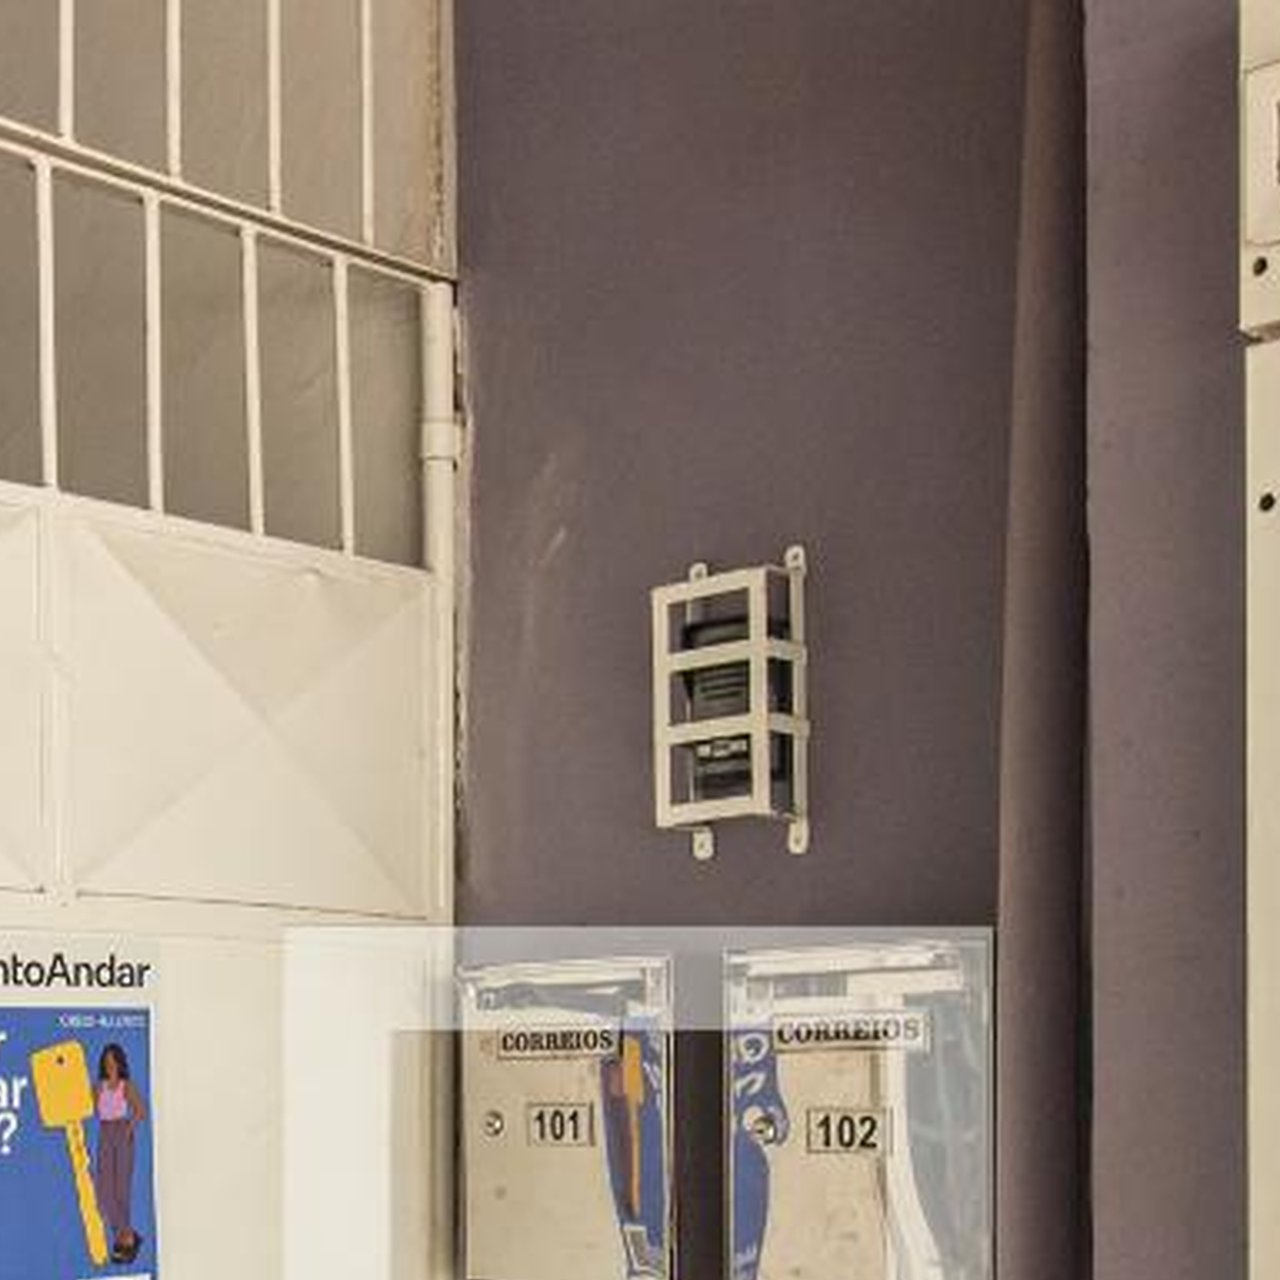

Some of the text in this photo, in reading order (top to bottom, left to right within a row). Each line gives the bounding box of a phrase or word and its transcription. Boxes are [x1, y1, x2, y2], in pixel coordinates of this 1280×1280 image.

[501, 1028, 614, 1052] CORREIOS
[776, 1017, 921, 1045] CORREIOS
[533, 1109, 580, 1141] 101
[816, 1114, 879, 1150] 102
